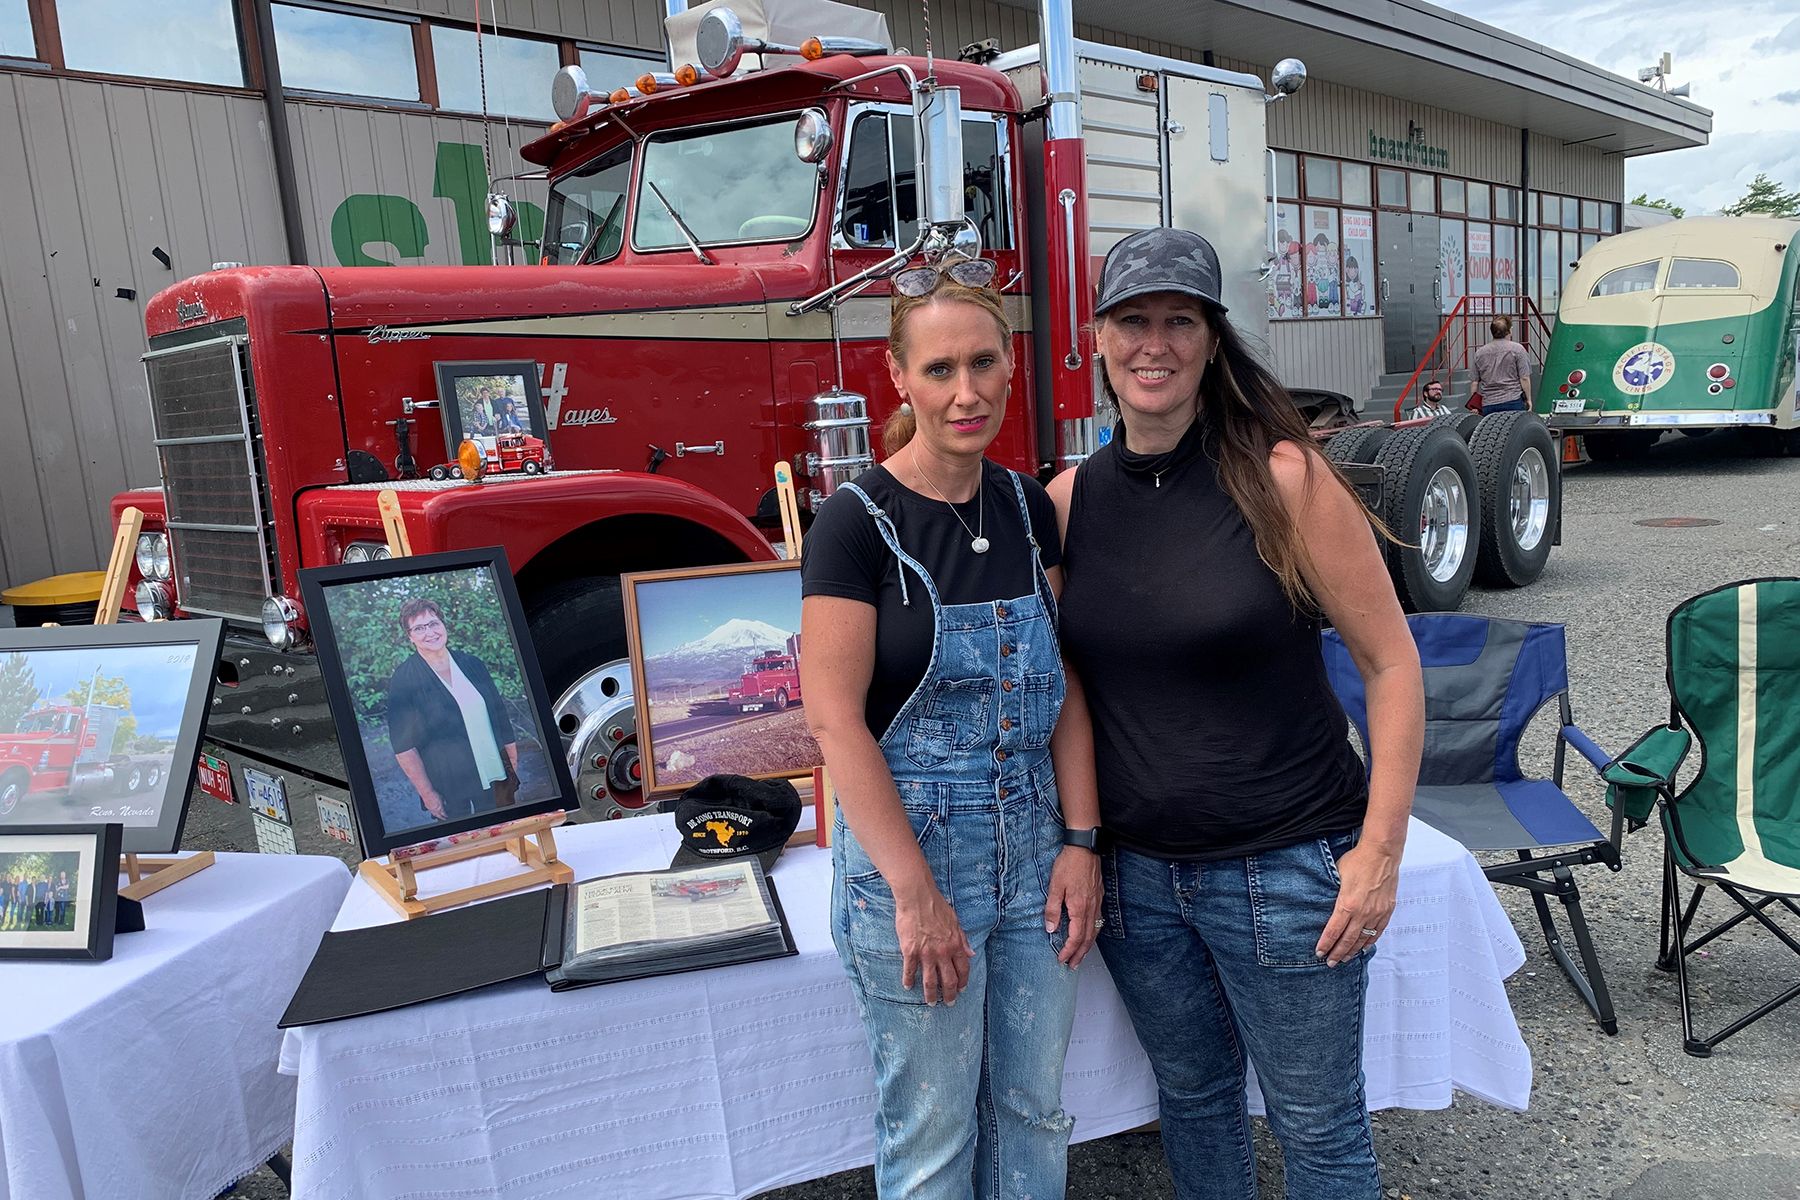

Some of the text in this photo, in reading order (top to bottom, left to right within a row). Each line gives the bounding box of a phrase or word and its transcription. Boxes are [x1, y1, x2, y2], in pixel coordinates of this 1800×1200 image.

[1368, 128, 1450, 169] boardroom
[1494, 258, 1514, 280] CARE
[1615, 344, 1673, 376] PACIFIC STAGE
[1625, 385, 1653, 393] LINES
[119, 805, 154, 817] Nevada
[686, 810, 753, 830] DE JONG TRANSPORT
